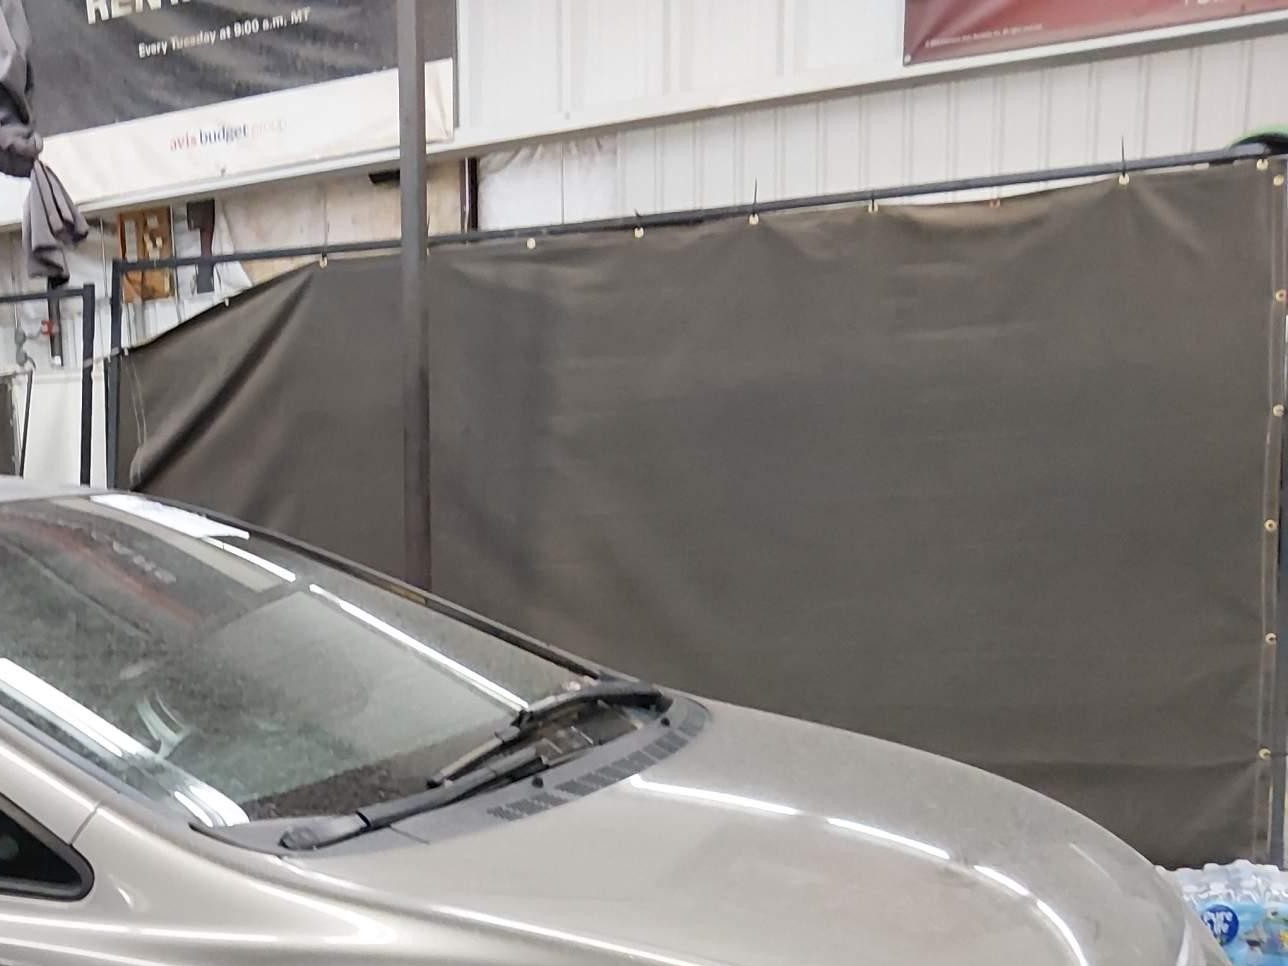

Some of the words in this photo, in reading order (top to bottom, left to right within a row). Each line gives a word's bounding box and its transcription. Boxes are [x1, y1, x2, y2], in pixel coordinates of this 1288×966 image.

[138, 41, 168, 58] Every
[171, 30, 216, 51] Tuesday
[219, 27, 231, 41] at
[199, 123, 248, 146] budget
